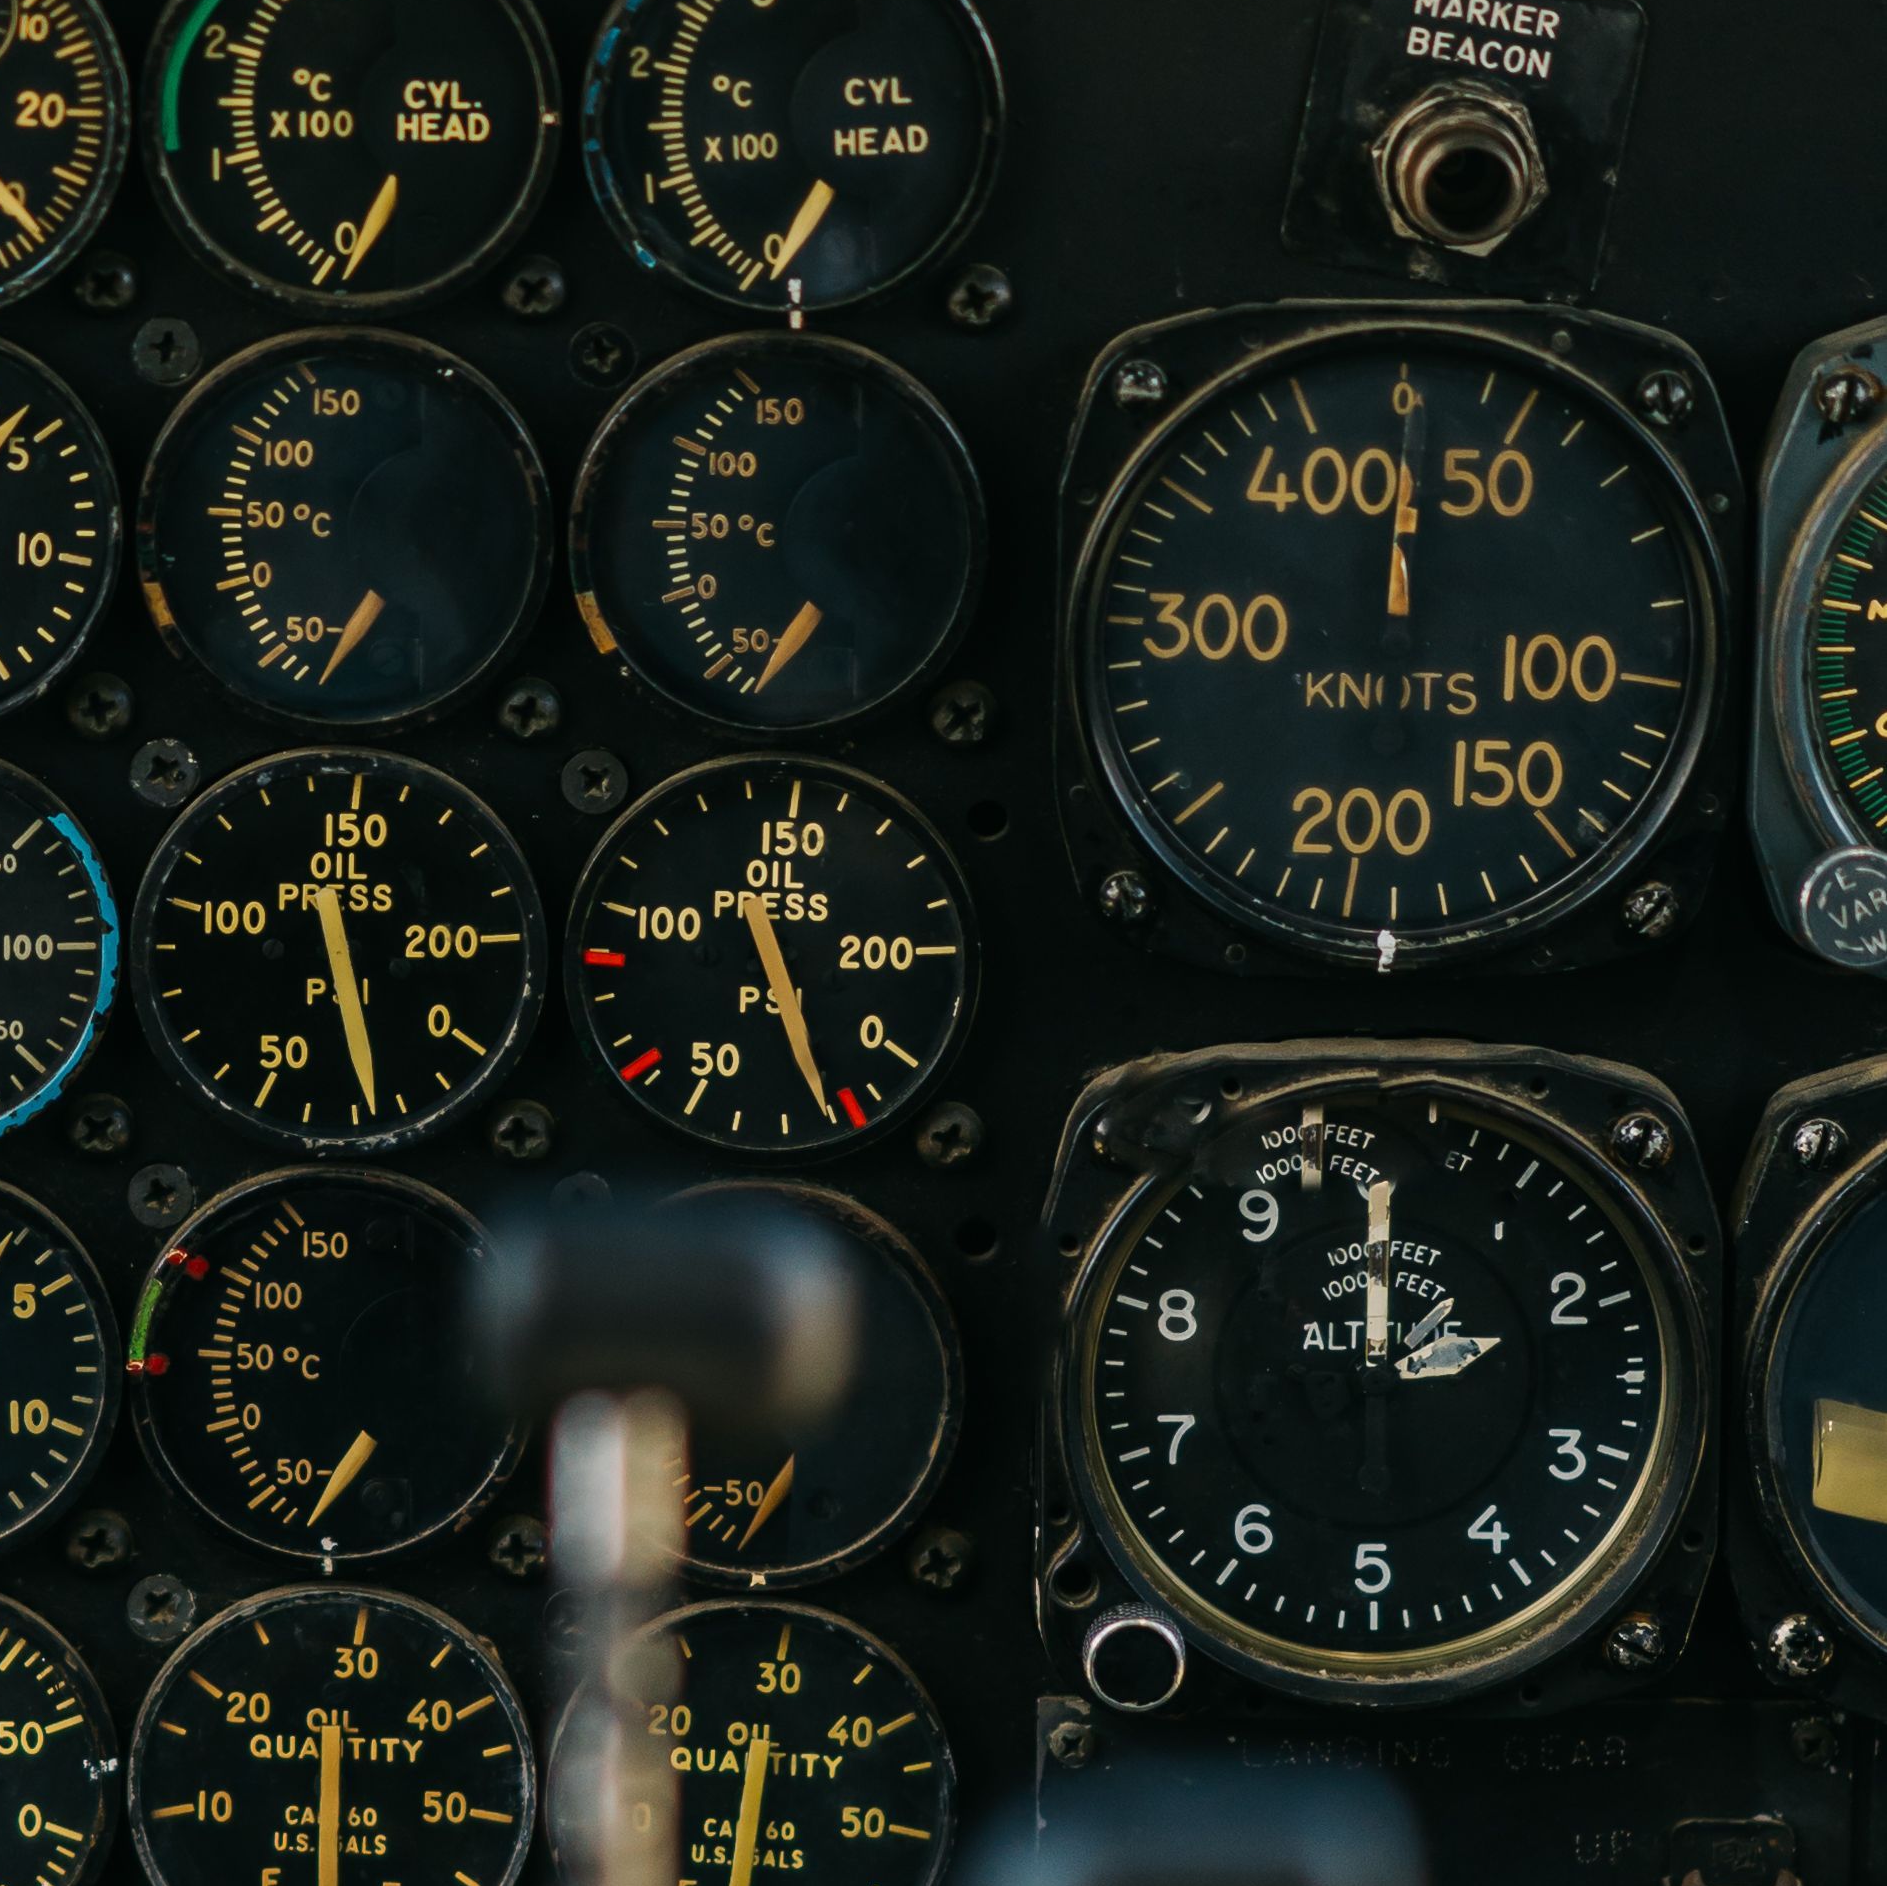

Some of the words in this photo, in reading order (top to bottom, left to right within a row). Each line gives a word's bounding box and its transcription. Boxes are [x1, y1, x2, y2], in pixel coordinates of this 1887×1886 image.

[1406, 27, 1552, 79] BEACON
[403, 81, 482, 109] CYL.
[844, 78, 911, 106] CYL
[16, 90, 66, 128] 20
[397, 113, 490, 142] HEAD
[834, 124, 929, 156] HEAD
[314, 389, 360, 416] 150
[1246, 446, 1396, 515] 400
[1440, 449, 1533, 517] 50
[1144, 592, 1288, 662] 300
[1503, 634, 1617, 703] 100
[1293, 788, 1431, 855] 200
[762, 821, 825, 856] 150
[311, 852, 367, 880] OIL
[747, 860, 804, 888] OIL
[205, 901, 267, 935] 100
[714, 891, 828, 921] PRESS
[639, 906, 701, 942] 100
[405, 925, 478, 959] 200
[839, 935, 913, 971] 200
[691, 1042, 740, 1077] 50
[1325, 1124, 1375, 1149] FEET
[1330, 1155, 1380, 1184] FEET
[1238, 1189, 1279, 1242] 9
[1390, 1241, 1441, 1266] FEET
[1395, 1272, 1446, 1301] FEET
[1158, 1289, 1197, 1341] 8
[1467, 1504, 1510, 1555] 4
[307, 1709, 358, 1734] OIL
[407, 1699, 452, 1732] 40
[827, 1715, 873, 1748] 40
[250, 1735, 423, 1763] QUATITY
[285, 1806, 319, 1826] CA
[347, 1807, 377, 1827] 60
[704, 1818, 739, 1839] CA
[765, 1821, 795, 1841] 60
